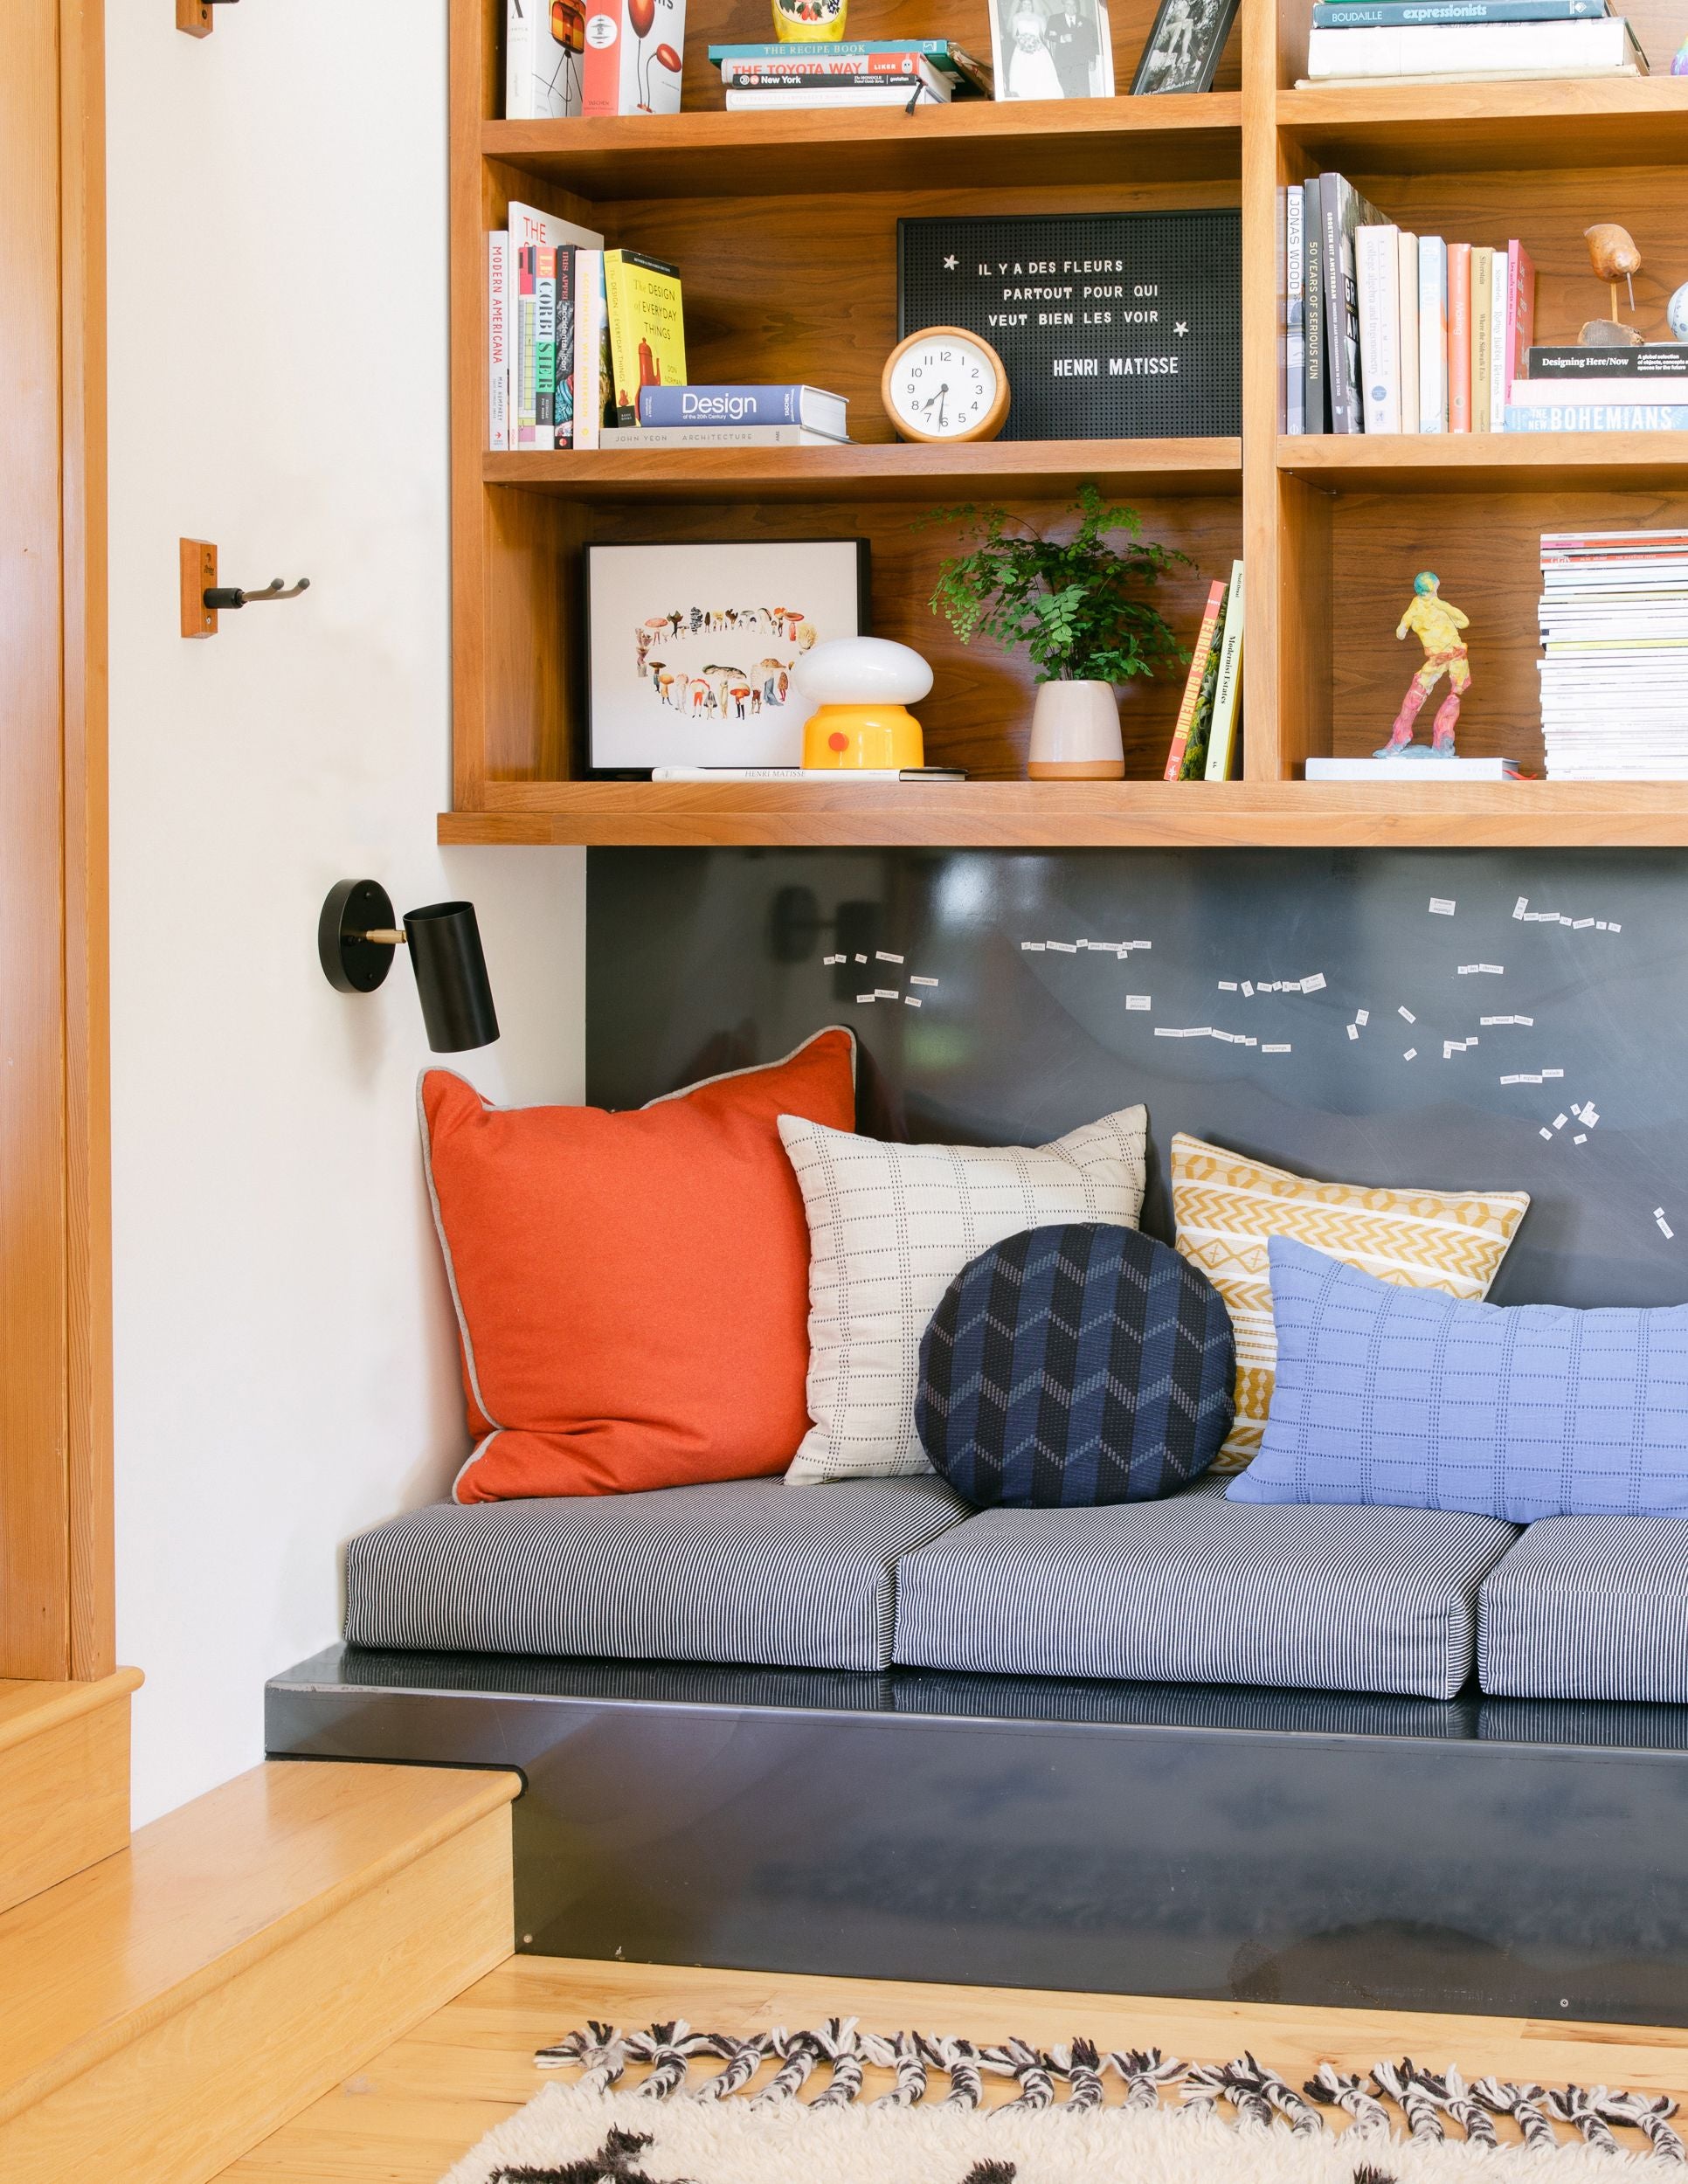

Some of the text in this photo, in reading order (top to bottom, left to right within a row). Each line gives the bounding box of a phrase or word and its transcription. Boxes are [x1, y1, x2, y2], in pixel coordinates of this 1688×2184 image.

[1332, 10, 1383, 23] BOUDAILLE
[1402, 3, 1487, 20] expressionists
[789, 45, 830, 54] RECIPE
[834, 44, 866, 52] BOOK
[733, 63, 863, 75] THE TOYOTA WAY
[781, 75, 801, 85] York
[523, 217, 546, 244] THE
[1290, 199, 1300, 290] JONAS WOOD
[538, 255, 553, 276] LE
[979, 260, 1124, 276] IL Y A DES FLEURS
[1328, 257, 1337, 299] AMSTERDAM
[633, 280, 675, 301] The DESIGN
[1003, 285, 1159, 301] PARTOUT POUR QUI
[493, 246, 503, 364] MODERN AMERICANA
[634, 301, 677, 322] of EVERYDAY
[1309, 241, 1318, 379] 50 YEARS OF SERIOUS FUN
[1365, 241, 1378, 376] college algebra and trigonometry
[988, 310, 1159, 328] VEUT BIEN LES VOIR
[1454, 301, 1464, 335] Making
[643, 322, 671, 341] THINGS
[924, 355, 934, 365] 11
[939, 351, 952, 363] 12
[961, 356, 965, 366] 1
[1541, 356, 1629, 369] Designing Here/Now
[910, 368, 923, 378] 10
[971, 368, 980, 378] 2
[1053, 356, 1180, 377] HENRI MATISSE
[1494, 363, 1503, 396] Returns
[907, 384, 915, 394] 9
[975, 384, 983, 395] 3
[682, 393, 757, 419] Design
[910, 400, 919, 411] 8
[971, 400, 979, 411] 4
[1531, 409, 1547, 418] THE
[924, 412, 932, 424] 7
[940, 417, 949, 428] 6
[958, 412, 966, 423] 5
[1528, 419, 1547, 430] NEW
[1550, 407, 1672, 430] BOHEMIANS
[1220, 636, 1235, 705] Modernist Estates
[1174, 617, 1216, 741] FEARLESS GARDENING
